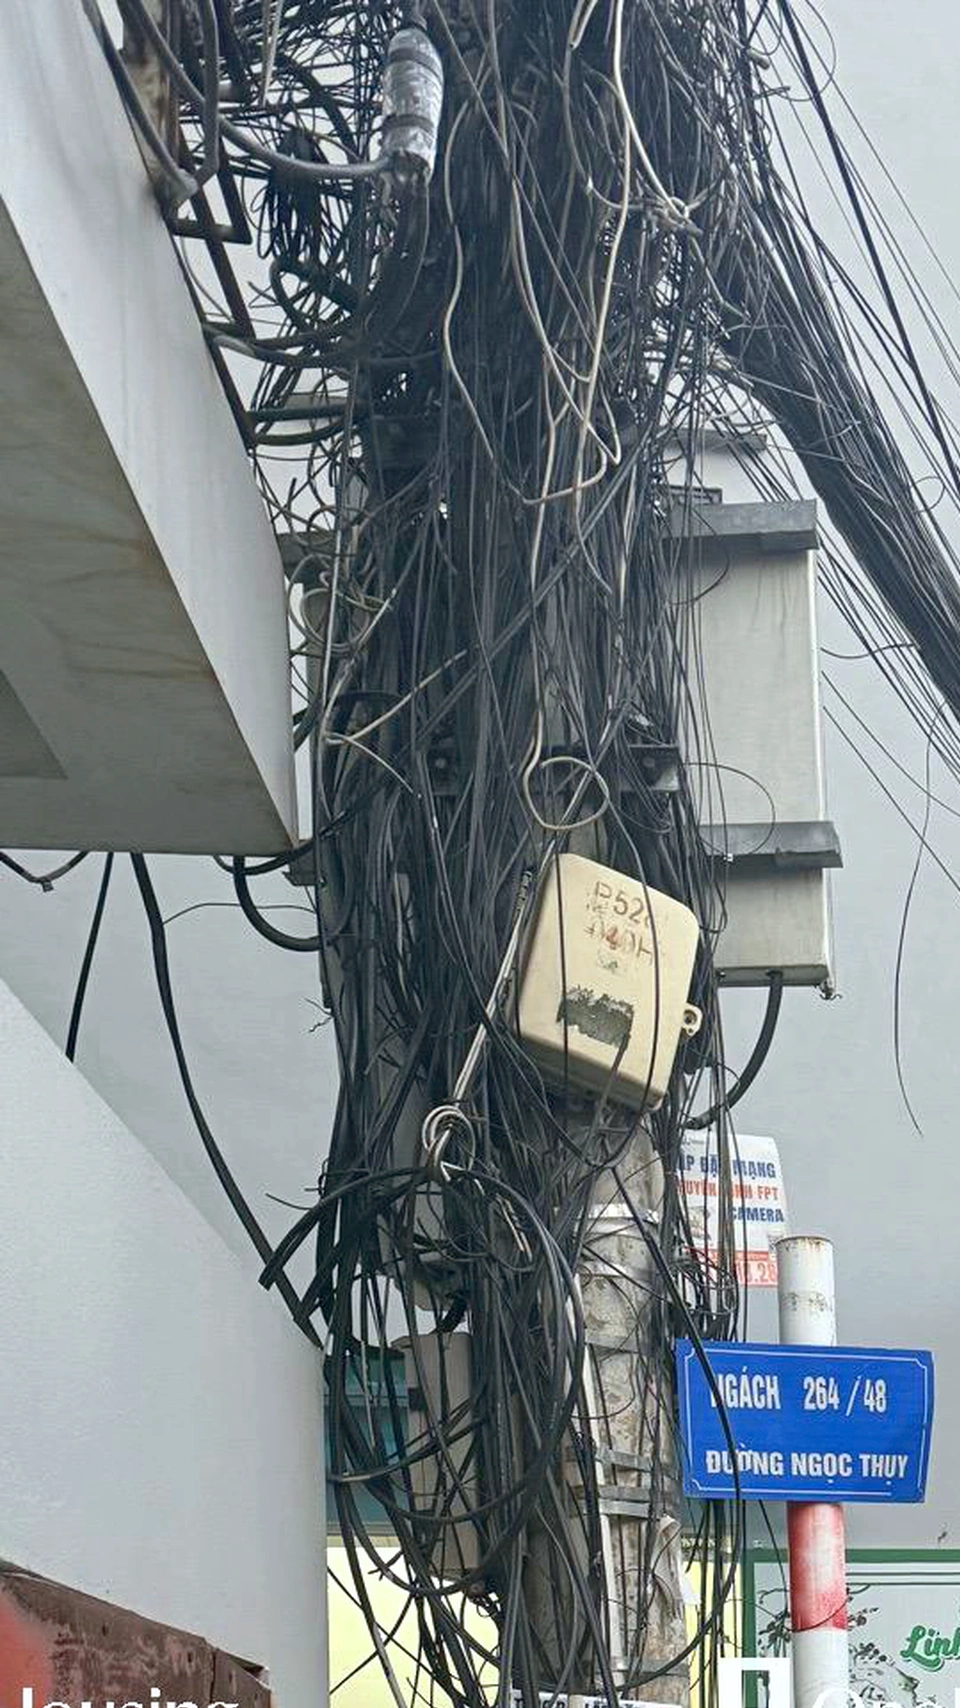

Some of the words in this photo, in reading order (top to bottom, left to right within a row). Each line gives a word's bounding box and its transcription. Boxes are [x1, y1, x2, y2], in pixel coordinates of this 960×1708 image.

[732, 1158, 777, 1180] MẠNG
[757, 1185, 779, 1200] FPT
[731, 1205, 785, 1223] CAMERA
[709, 1366, 782, 1410] NGÁCH
[791, 1452, 853, 1484] NGỌC
[858, 1453, 909, 1486] THỤY
